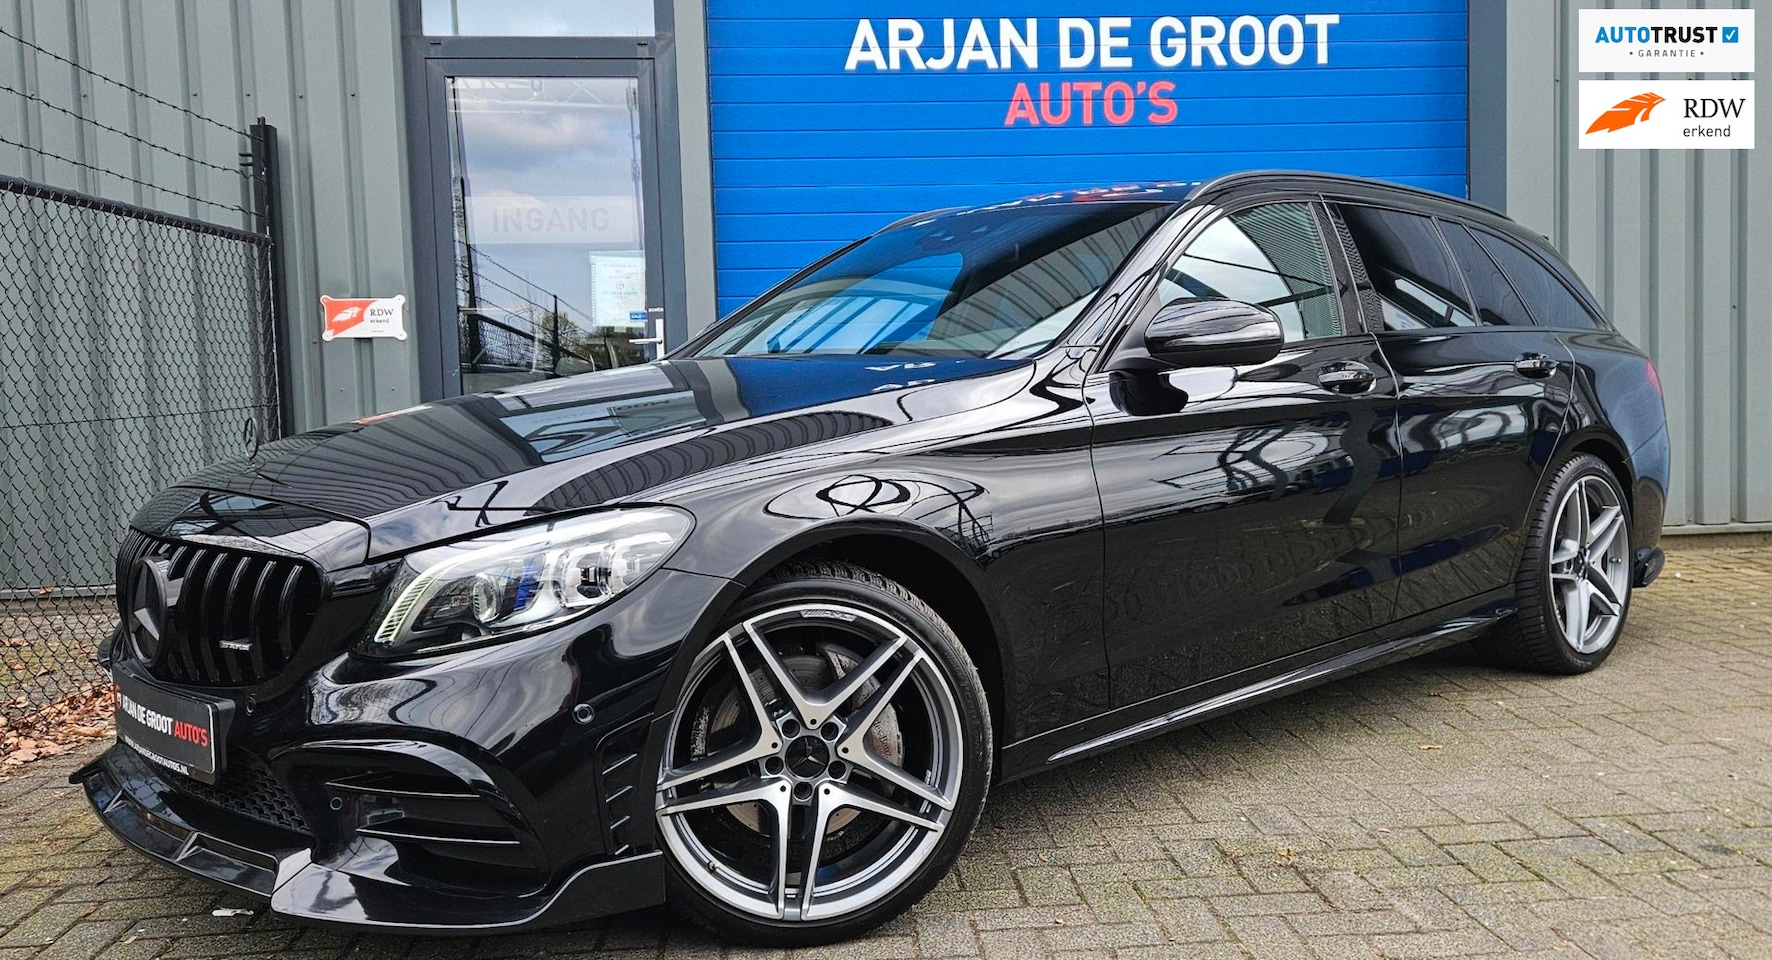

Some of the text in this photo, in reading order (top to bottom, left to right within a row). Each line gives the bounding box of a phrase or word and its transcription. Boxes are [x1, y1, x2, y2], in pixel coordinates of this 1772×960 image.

[844, 13, 1340, 70] ARJAN DE GROOT
[1004, 81, 1179, 126] AUTO'S
[492, 207, 610, 233] INGANG
[369, 308, 394, 317] RDW
[122, 694, 208, 747] ARJAN DE GROOT AUTO'S
